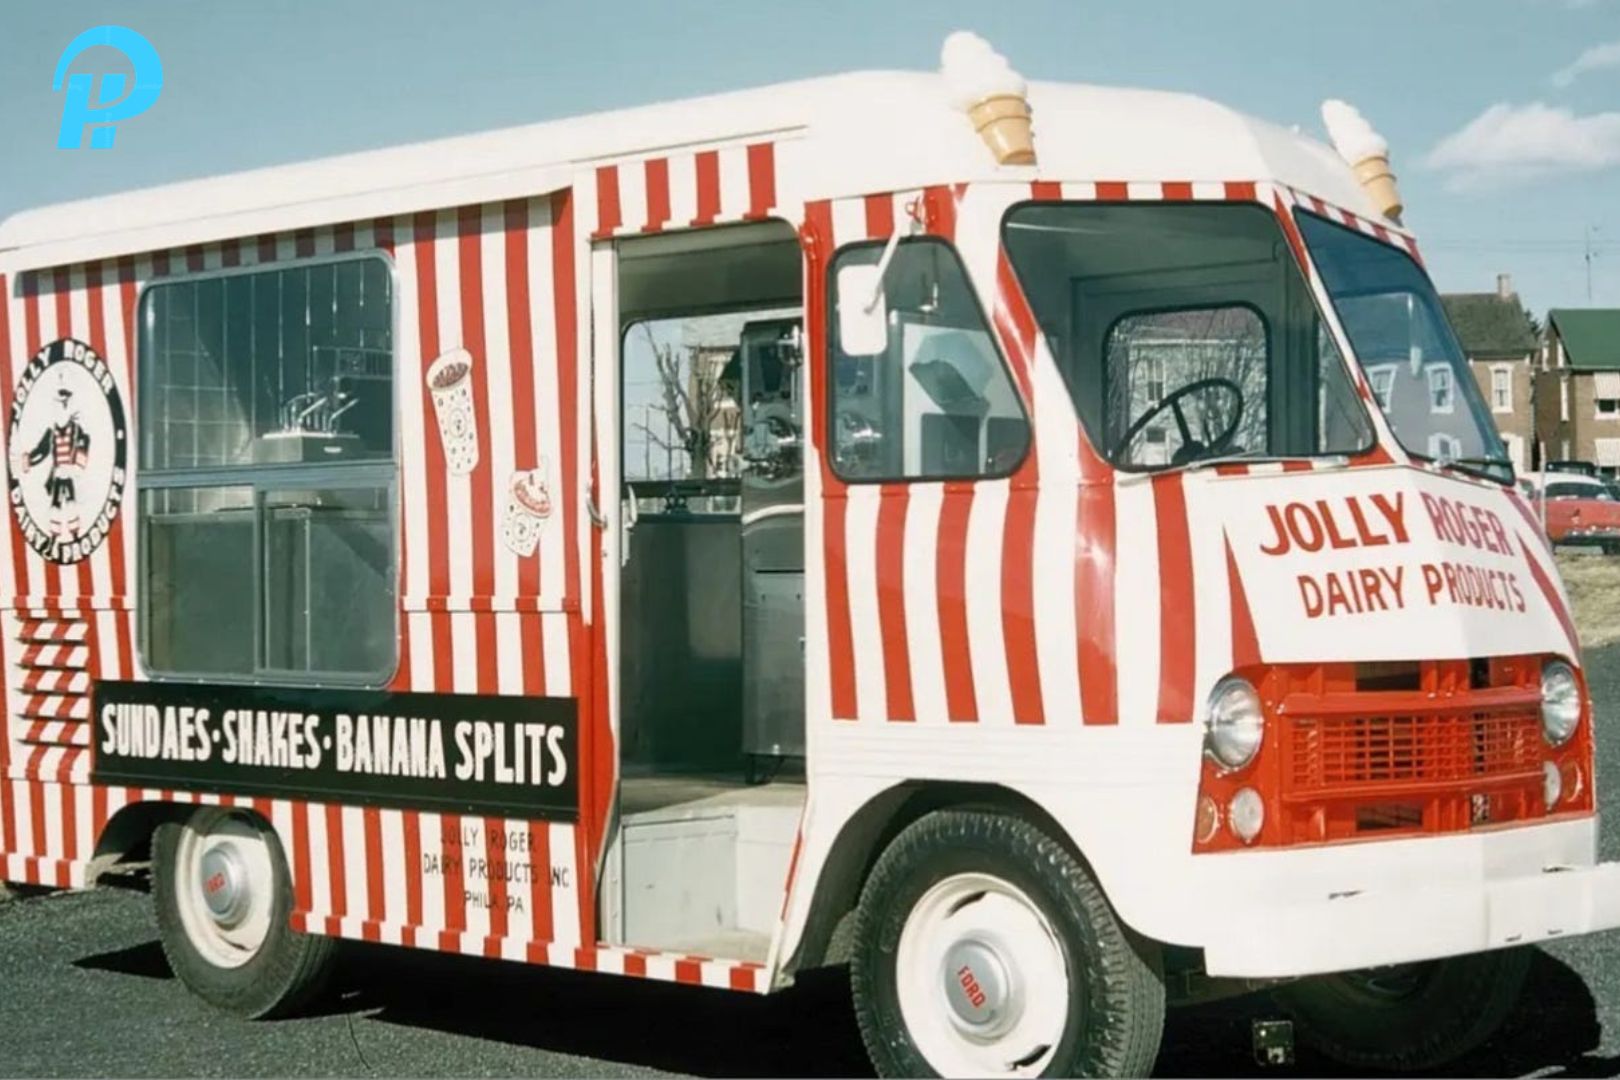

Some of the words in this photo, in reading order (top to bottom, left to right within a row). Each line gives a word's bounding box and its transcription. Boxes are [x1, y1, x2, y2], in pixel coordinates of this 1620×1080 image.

[12, 345, 51, 421] JOLLY
[63, 339, 113, 395] ROGER
[10, 486, 49, 551] DAIRY
[1260, 492, 1410, 556] JOLLY
[1419, 491, 1514, 556] ROGER
[1297, 566, 1404, 618] DAIRY
[1421, 561, 1526, 613] PRODUCTS
[101, 703, 211, 761] SUNDAES
[222, 709, 321, 770] SHAKES
[336, 714, 446, 780] BANANA
[454, 720, 567, 787] SPLITS
[441, 825, 478, 846] JOLLY
[486, 829, 536, 852] ROGER
[424, 853, 462, 875] DAIRY
[469, 857, 537, 884] PRODUCTS
[507, 896, 523, 912] PA
[958, 966, 986, 1007] FORD
